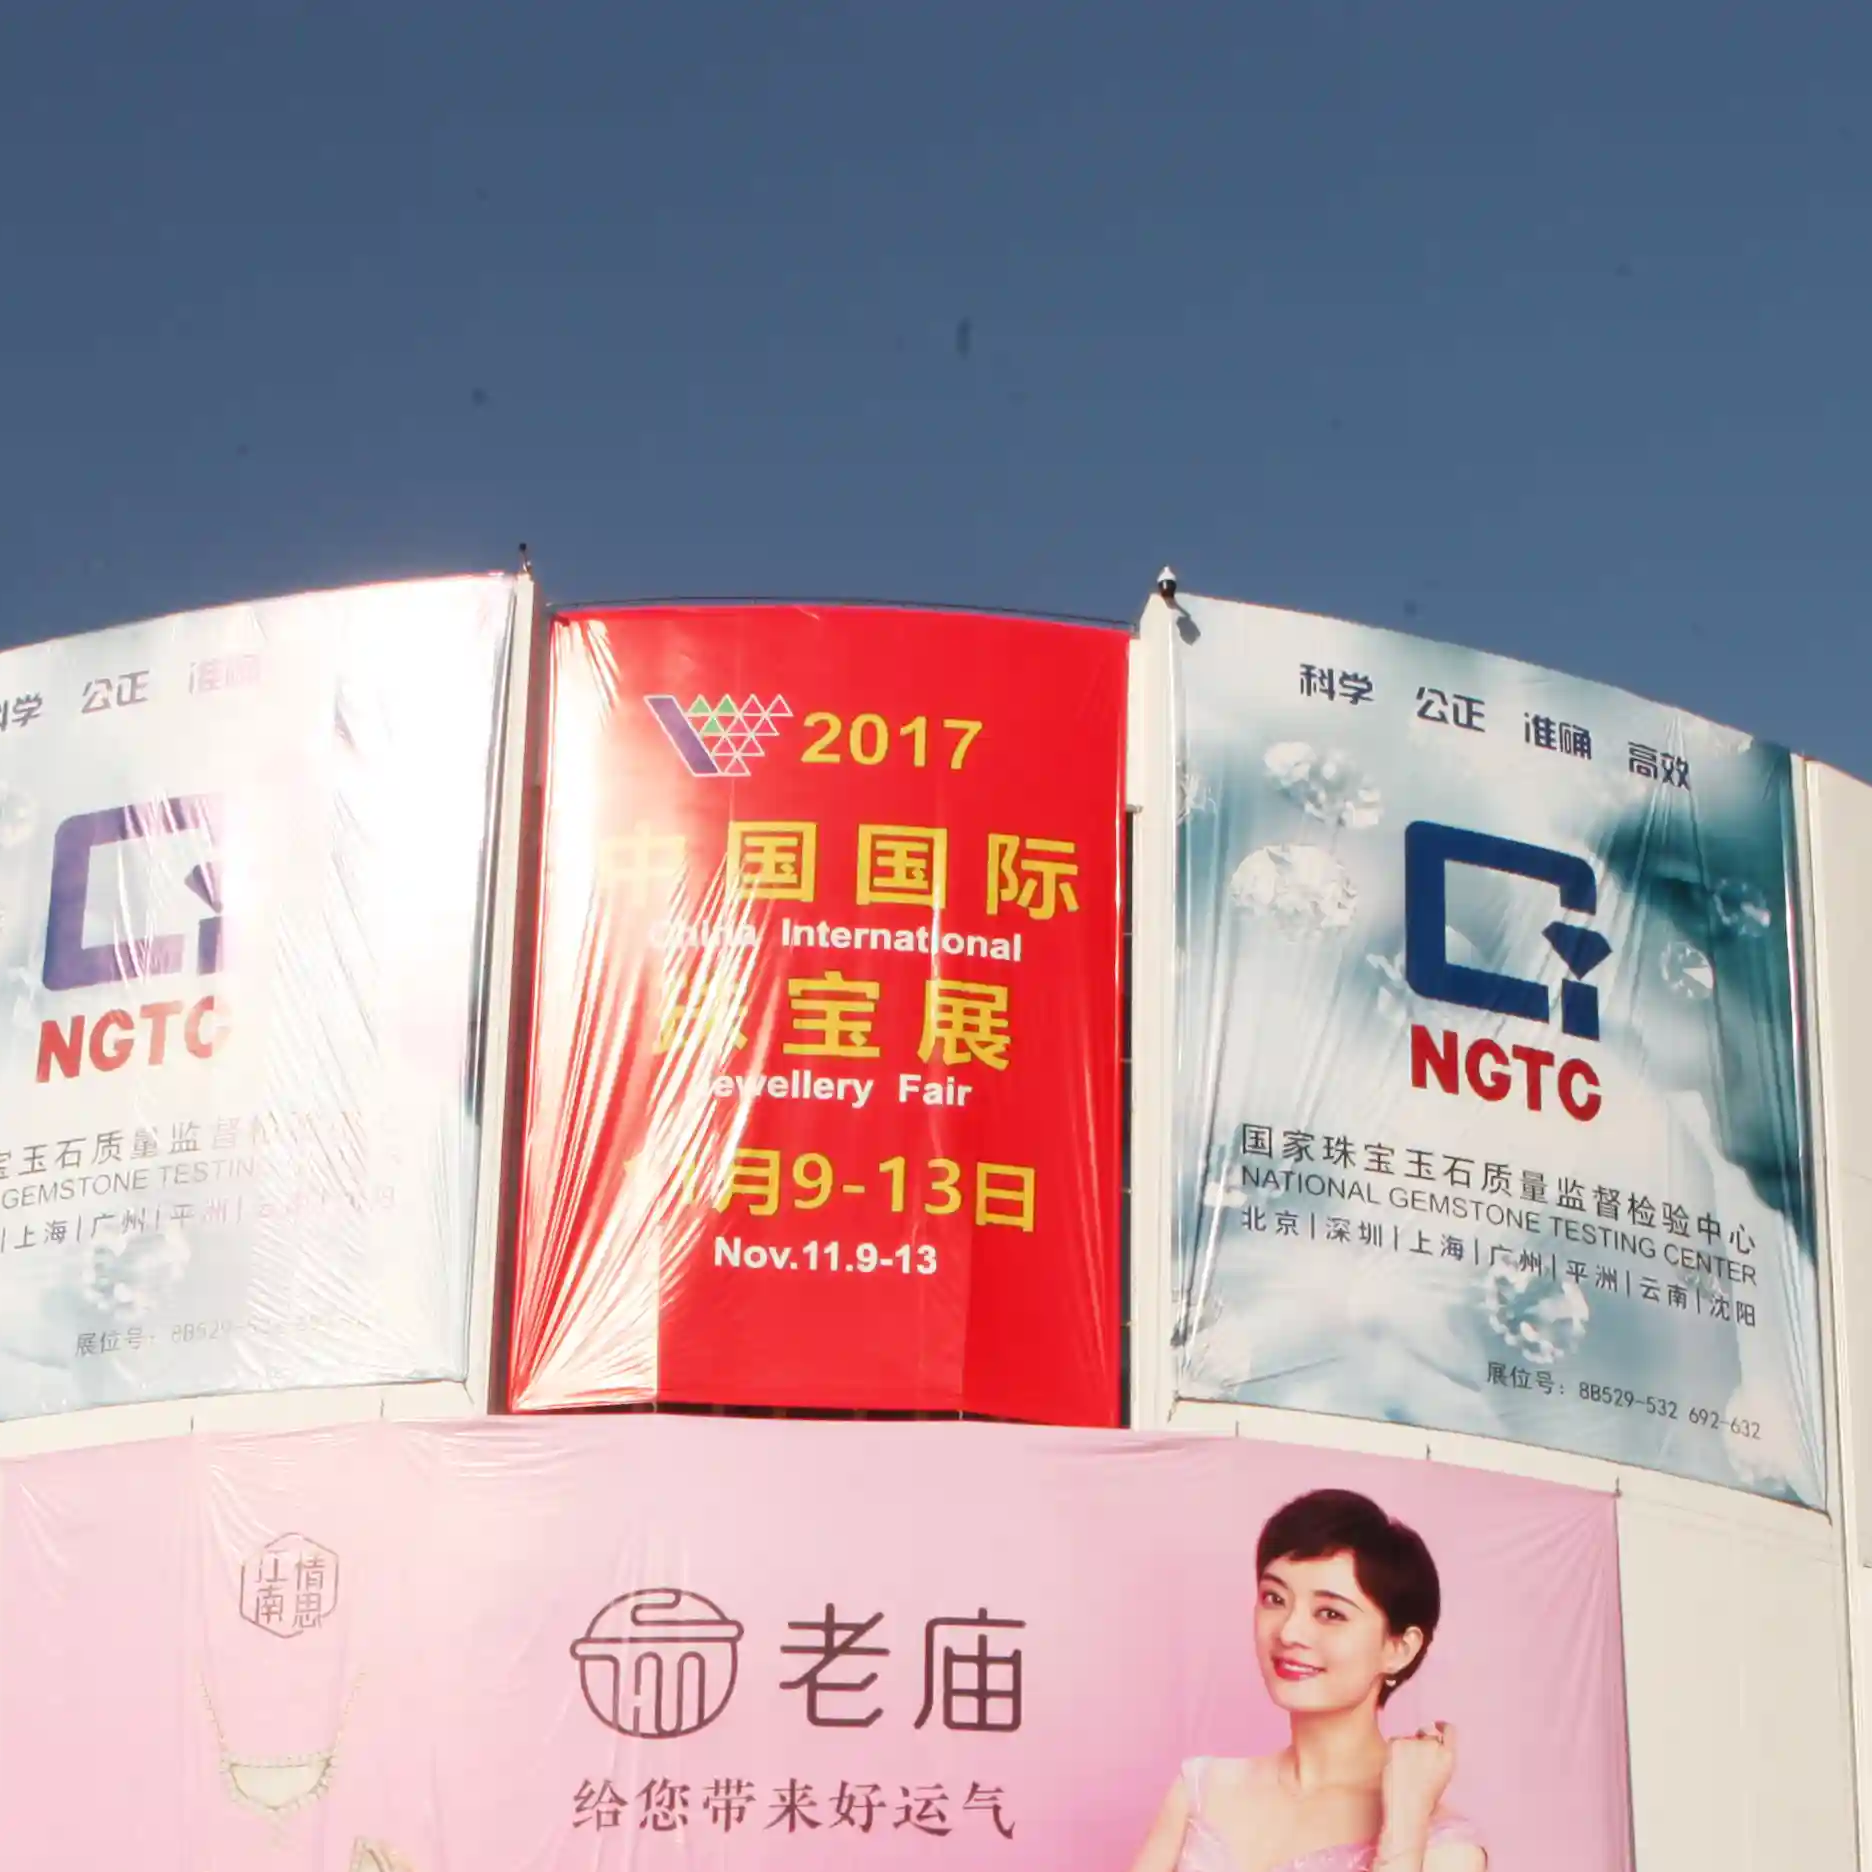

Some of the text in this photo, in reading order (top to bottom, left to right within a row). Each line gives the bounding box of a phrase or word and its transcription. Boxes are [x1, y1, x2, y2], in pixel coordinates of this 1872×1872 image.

[81, 670, 150, 714] 公正
[1299, 663, 1692, 790] 科学 公正 准确 高效
[801, 712, 983, 769] 2017
[598, 818, 1079, 921] 中国国际
[782, 917, 1022, 963] International
[35, 994, 231, 1084] NGTC
[1410, 1023, 1602, 1122] NGTC
[698, 1068, 973, 1108] ewellery Fair
[1, 1169, 149, 1211] GEMSTONE
[158, 1155, 256, 1186] TESTIN
[625, 1147, 1036, 1234] 月9-13日
[1241, 1121, 1757, 1257] 国家珠宝玉石质量监督检验中心
[1241, 1163, 1758, 1289] NATIONAL GEMSTONE TESTING CENTER
[713, 1235, 939, 1275] Nov.11.9-13
[779, 1602, 1027, 1733] 老庙
[572, 1777, 1017, 1840] 给您带来好运气
